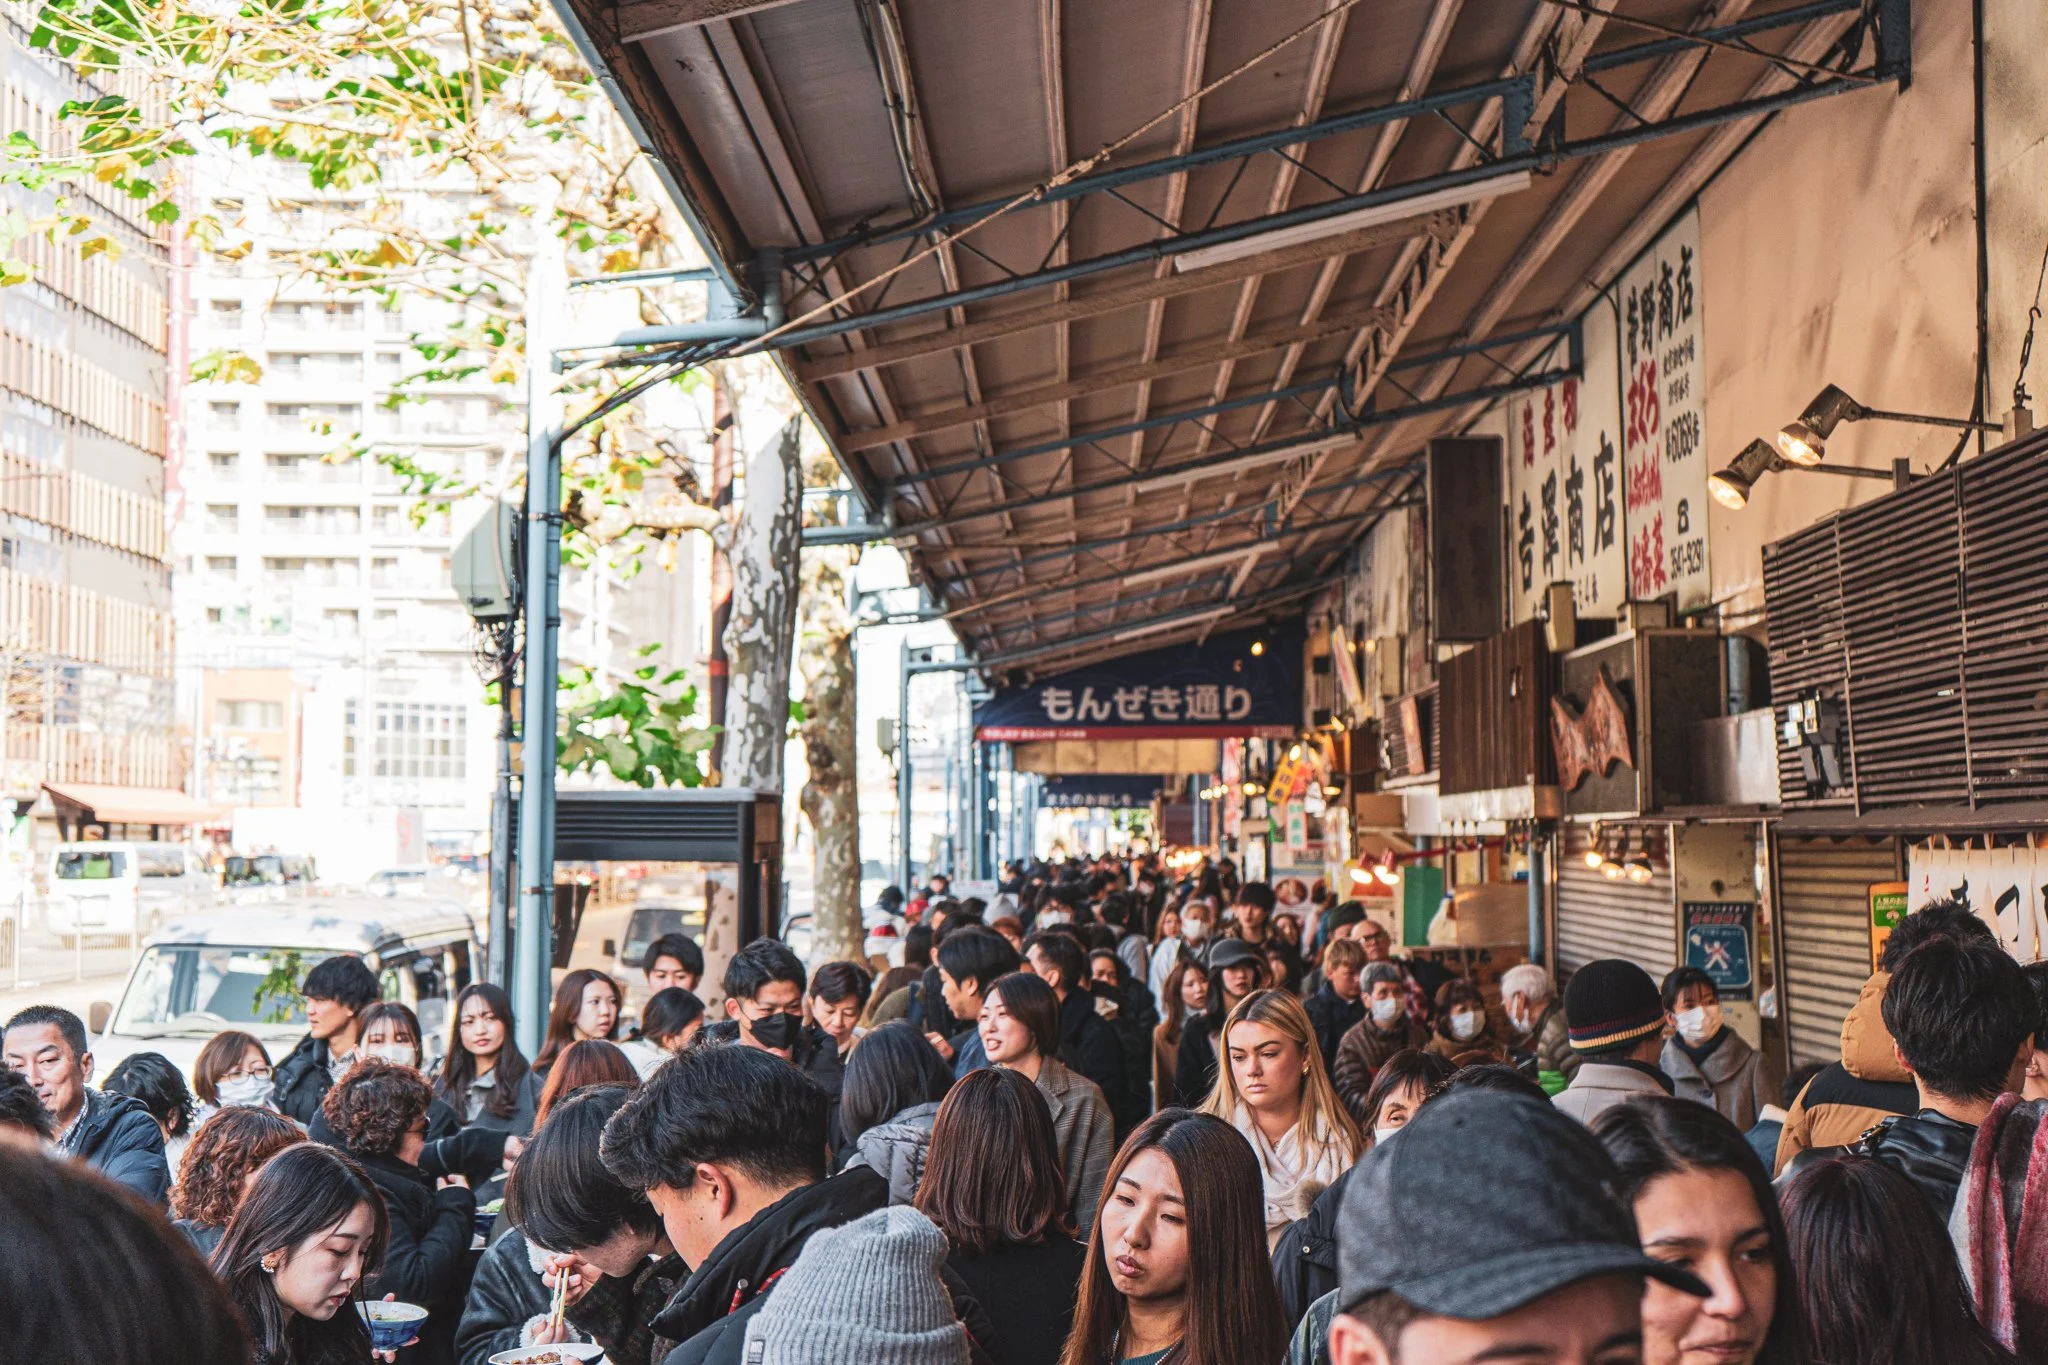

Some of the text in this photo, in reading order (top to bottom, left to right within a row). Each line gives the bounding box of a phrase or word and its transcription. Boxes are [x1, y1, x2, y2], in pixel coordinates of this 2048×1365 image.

[1627, 360, 1659, 450] まぐろ
[1041, 684, 1252, 721] もんぜき通り
